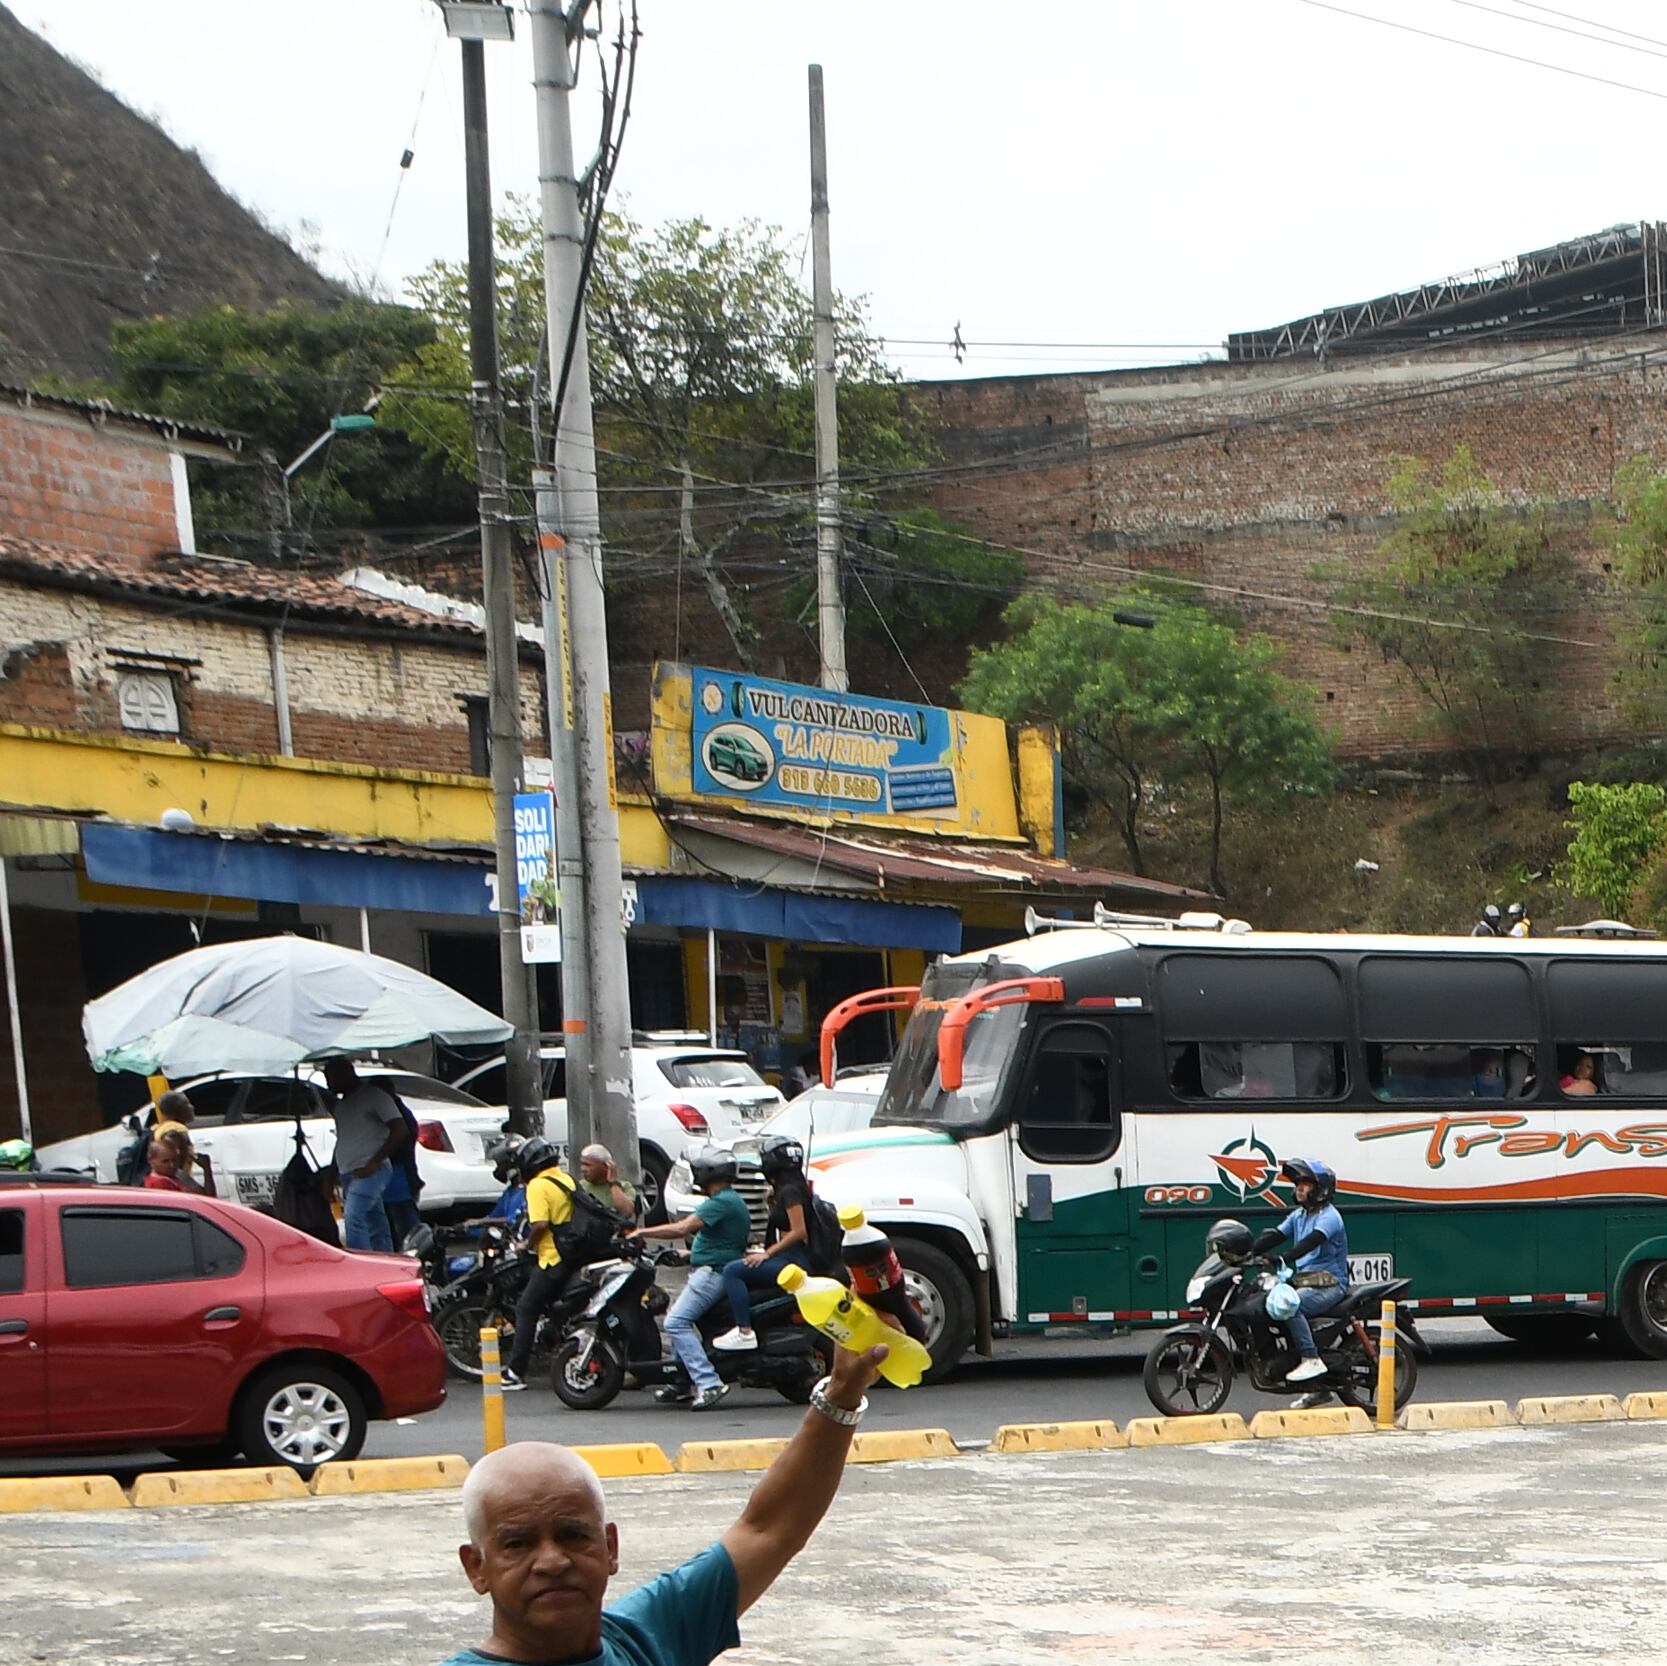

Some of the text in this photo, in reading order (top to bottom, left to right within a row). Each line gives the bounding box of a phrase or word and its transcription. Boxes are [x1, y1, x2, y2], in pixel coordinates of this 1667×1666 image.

[748, 690, 915, 738] VULCANIZADORA
[514, 808, 547, 833] SOLI
[518, 859, 548, 885] DAD
[1144, 1185, 1213, 1206] 090
[1364, 1259, 1389, 1282] 016
